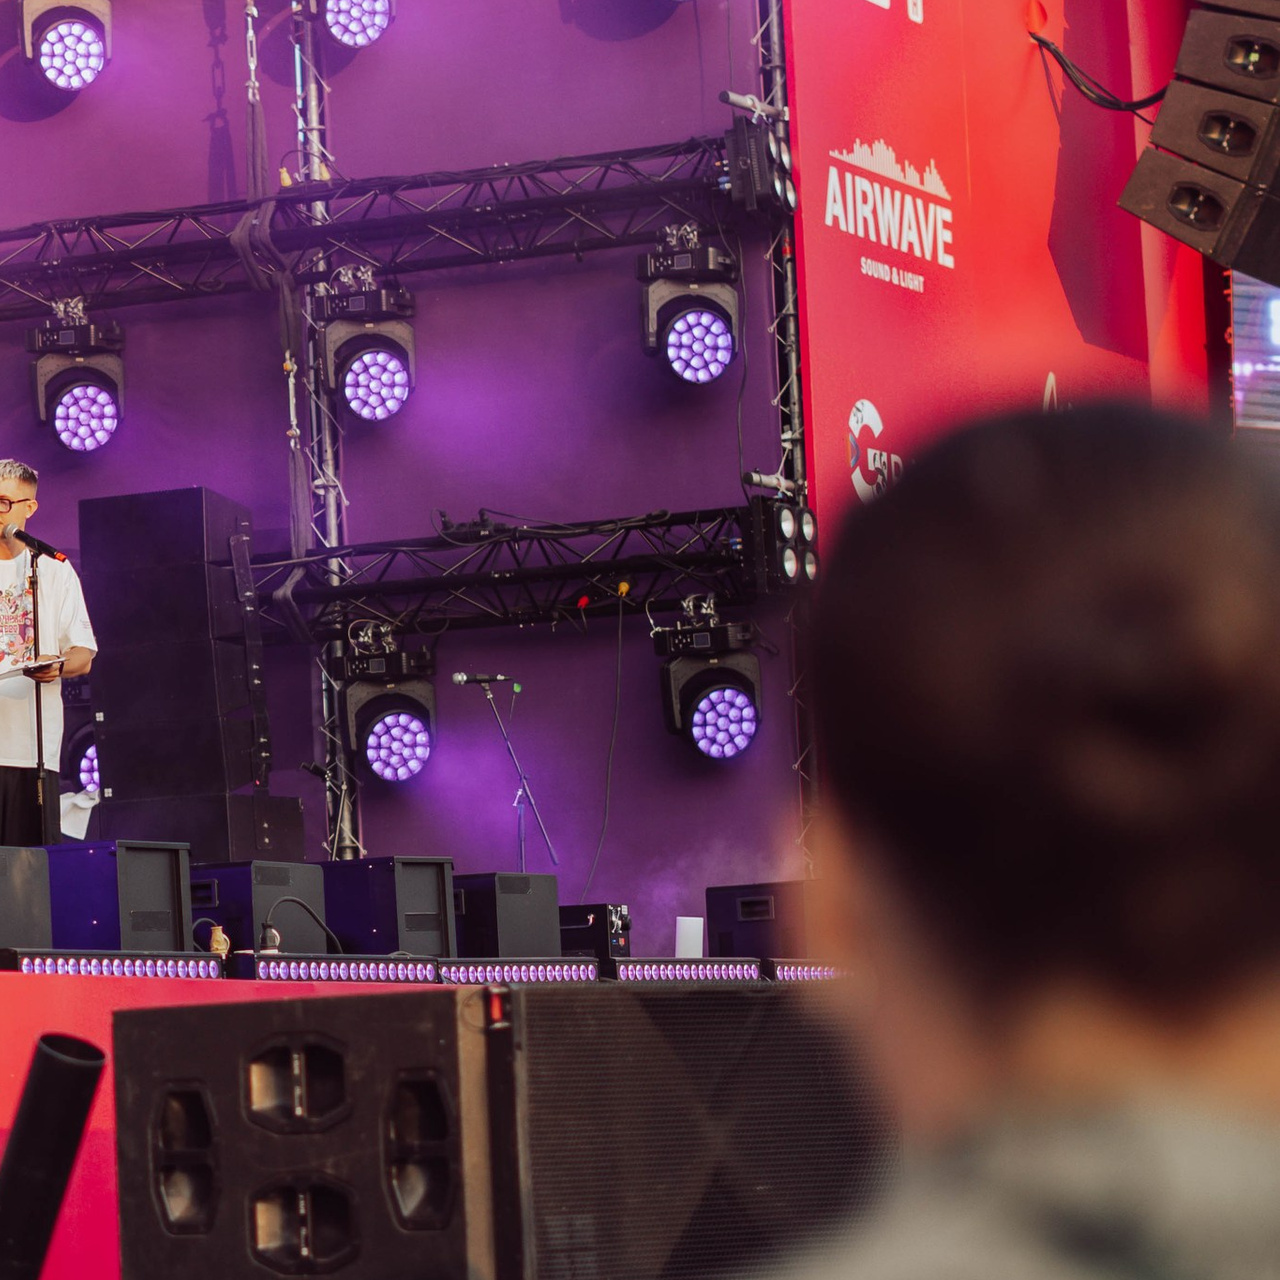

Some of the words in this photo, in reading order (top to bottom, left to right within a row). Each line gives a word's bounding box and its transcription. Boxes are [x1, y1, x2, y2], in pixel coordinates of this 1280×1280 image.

[825, 165, 955, 270] AIRWAVE
[860, 256, 891, 282] SOUND
[891, 266, 900, 285] &
[900, 269, 925, 293] LIGHT
